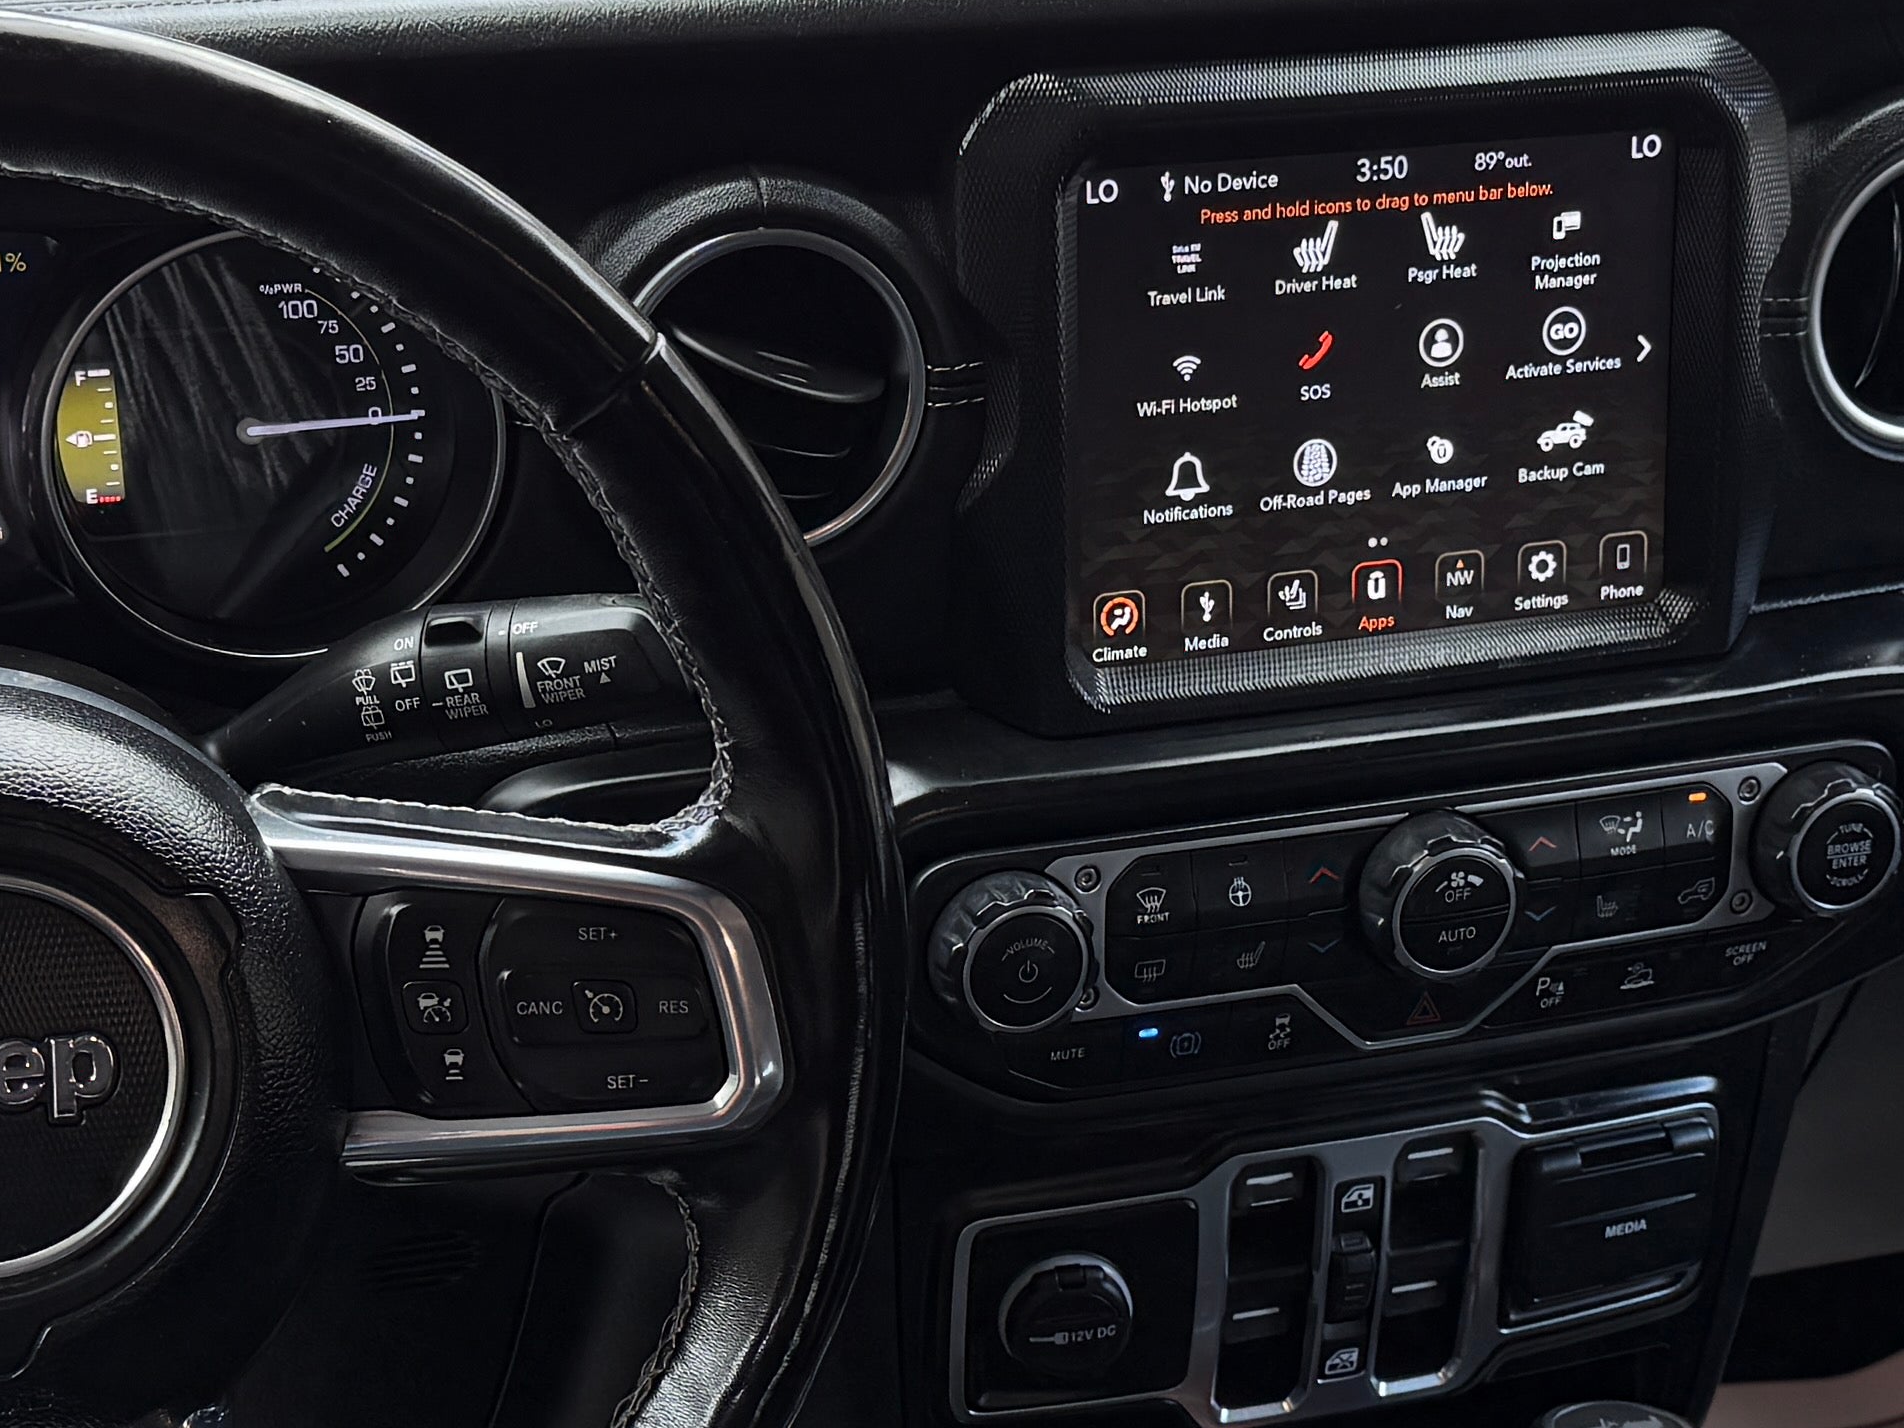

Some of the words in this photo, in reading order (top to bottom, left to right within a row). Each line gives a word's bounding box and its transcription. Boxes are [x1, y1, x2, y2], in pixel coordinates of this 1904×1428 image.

[1631, 134, 1662, 159] LO
[1356, 156, 1408, 183] 3:50
[1185, 175, 1212, 194] No
[1218, 171, 1278, 193] Device
[1086, 179, 1118, 204] LO
[1201, 209, 1238, 224] Press
[1243, 205, 1271, 221] and
[1276, 201, 1309, 219] hold
[1315, 198, 1352, 215] icons
[1356, 197, 1370, 210] to
[1376, 195, 1409, 212] drag
[1414, 193, 1429, 207] to
[1433, 189, 1474, 205] menu
[1479, 185, 1503, 201] bar
[1508, 182, 1553, 198] below.
[1531, 253, 1601, 274] Projection
[1408, 267, 1438, 284] Psgr
[1442, 263, 1477, 280] Heat
[1535, 272, 1597, 290] Manager
[258, 282, 303, 296] %PWR
[1275, 279, 1318, 295] Driver
[1322, 274, 1357, 291] Heat
[1147, 288, 1192, 307] Travel
[1196, 285, 1225, 302] Link
[278, 300, 318, 320] 100
[318, 320, 339, 334] 75
[1549, 322, 1580, 340] GO
[335, 344, 364, 364] 50
[1505, 362, 1563, 381] Activate
[1565, 355, 1621, 374] Services
[74, 370, 87, 386] F
[355, 377, 377, 391] 25
[1421, 372, 1460, 389] Assist
[1300, 384, 1331, 401] SOS
[1136, 399, 1176, 418] Wi-Fi
[1179, 393, 1238, 416] Hotspot
[1518, 463, 1568, 484] Backup
[1573, 460, 1605, 478] Cam
[1392, 481, 1423, 499] App
[1426, 473, 1488, 496] Manager
[86, 488, 99, 504] E
[331, 463, 378, 528] CHARGE
[1260, 492, 1326, 513] Off-Road
[1329, 487, 1372, 508] Pages
[1143, 502, 1234, 526] Notifications
[1446, 570, 1475, 587] NW
[1600, 582, 1645, 602] Phone
[1514, 592, 1569, 613] Settings
[1446, 603, 1474, 620] Nav
[512, 621, 538, 636] OFF
[1358, 614, 1395, 632] Apps
[1263, 621, 1323, 643] Controls
[393, 636, 414, 651] ON
[1184, 633, 1230, 653] Media
[1092, 642, 1148, 664] Climate
[584, 656, 617, 674] MIST
[537, 676, 581, 693] FRONT
[355, 695, 380, 706] PULL
[395, 697, 420, 712] OFF
[446, 693, 481, 707] REAR
[541, 688, 586, 704] WIPER
[445, 704, 489, 720] WIPER
[365, 731, 392, 743] PUSH
[1686, 820, 1715, 843] A/C
[1610, 844, 1637, 857] MODE
[1827, 840, 1872, 856] BROWSE
[1832, 855, 1867, 869] ENTER
[1444, 888, 1472, 903] OFF
[1137, 912, 1170, 924] FRONT
[577, 926, 619, 942] SET+
[1438, 927, 1476, 943] AUTO
[1005, 937, 1049, 956] VOLUME
[1725, 941, 1767, 957] SCREEN
[1733, 952, 1754, 966] OFF
[516, 1000, 564, 1017] CANC
[658, 999, 690, 1015] RES
[1540, 994, 1562, 1009] OFF
[1268, 1038, 1290, 1050] OFF
[1050, 1047, 1086, 1061] MUTE
[1604, 1217, 1649, 1240] MEDIA
[1069, 1326, 1095, 1345] 12V
[1096, 1323, 1117, 1341] DC
